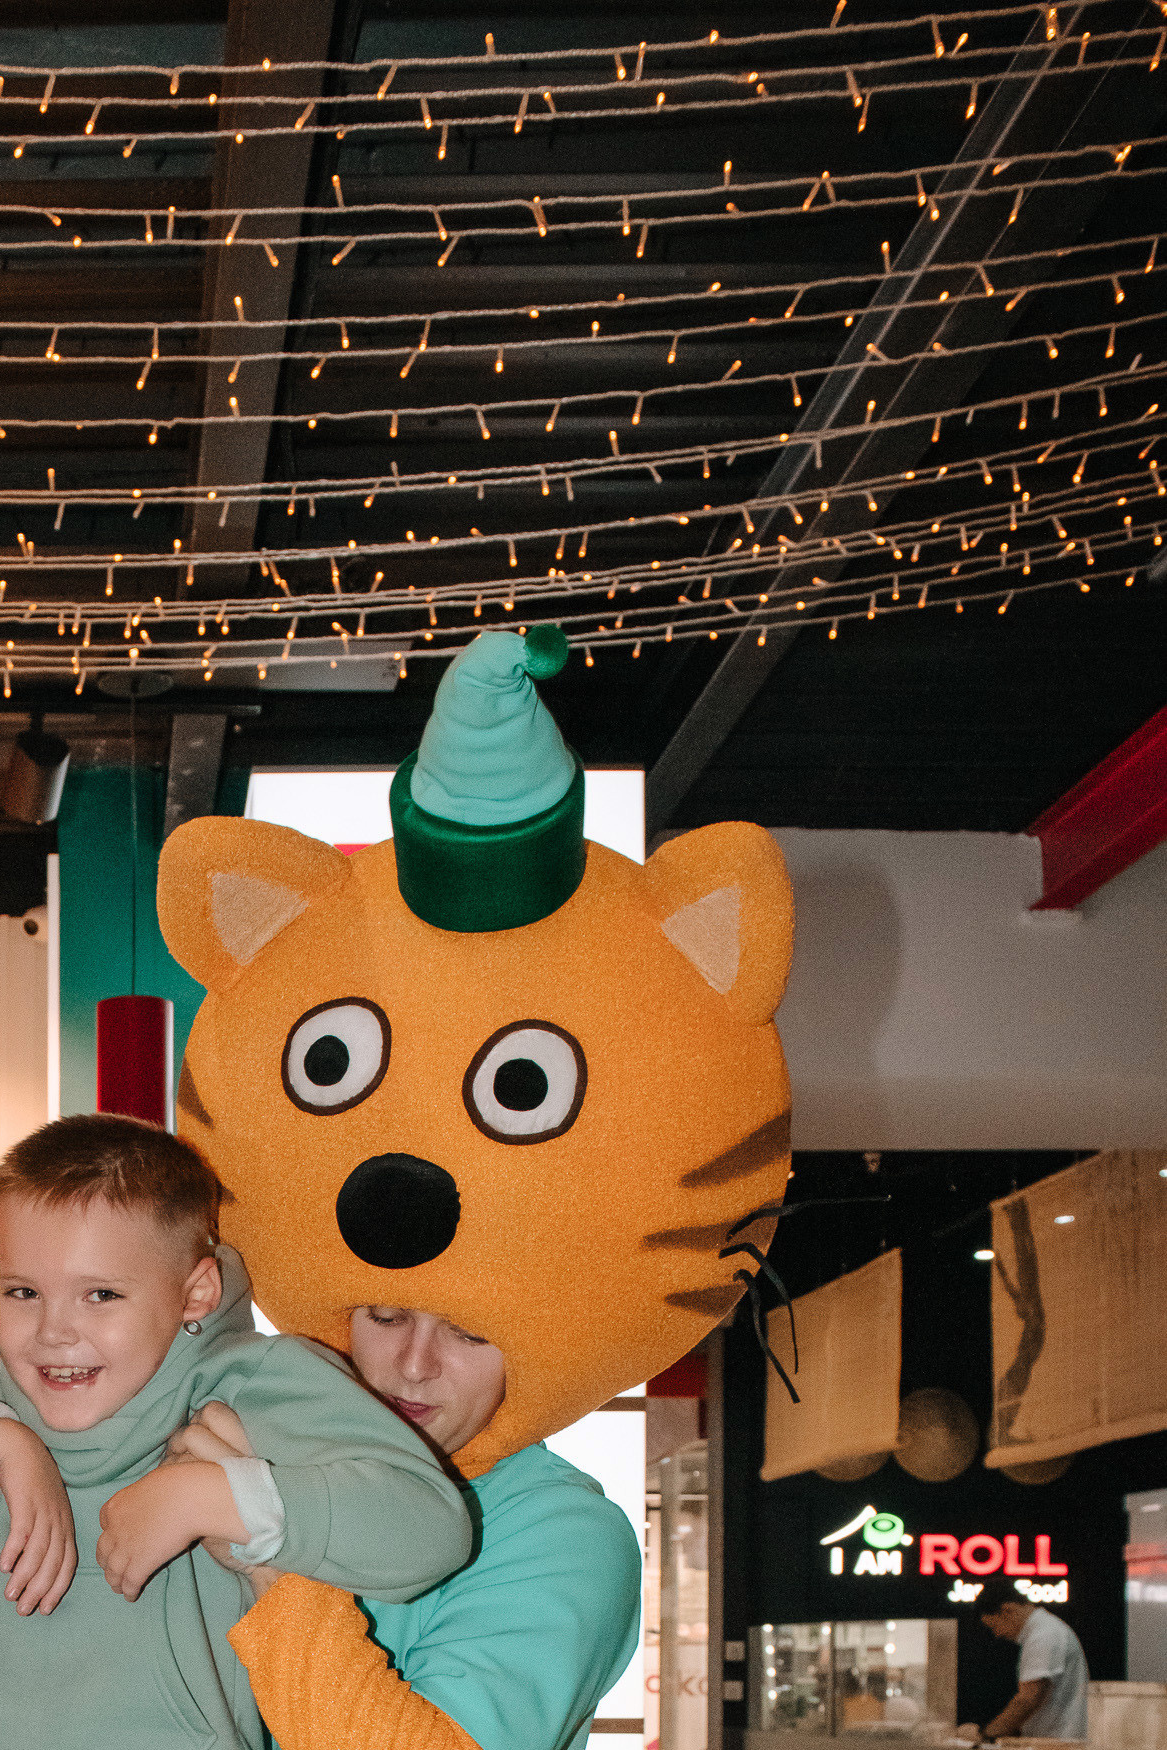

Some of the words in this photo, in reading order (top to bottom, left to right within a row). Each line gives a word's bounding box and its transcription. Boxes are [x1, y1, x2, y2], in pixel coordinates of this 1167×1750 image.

[830, 1547, 843, 1575] I
[854, 1550, 902, 1575] AM
[919, 1534, 1068, 1576] ROLL
